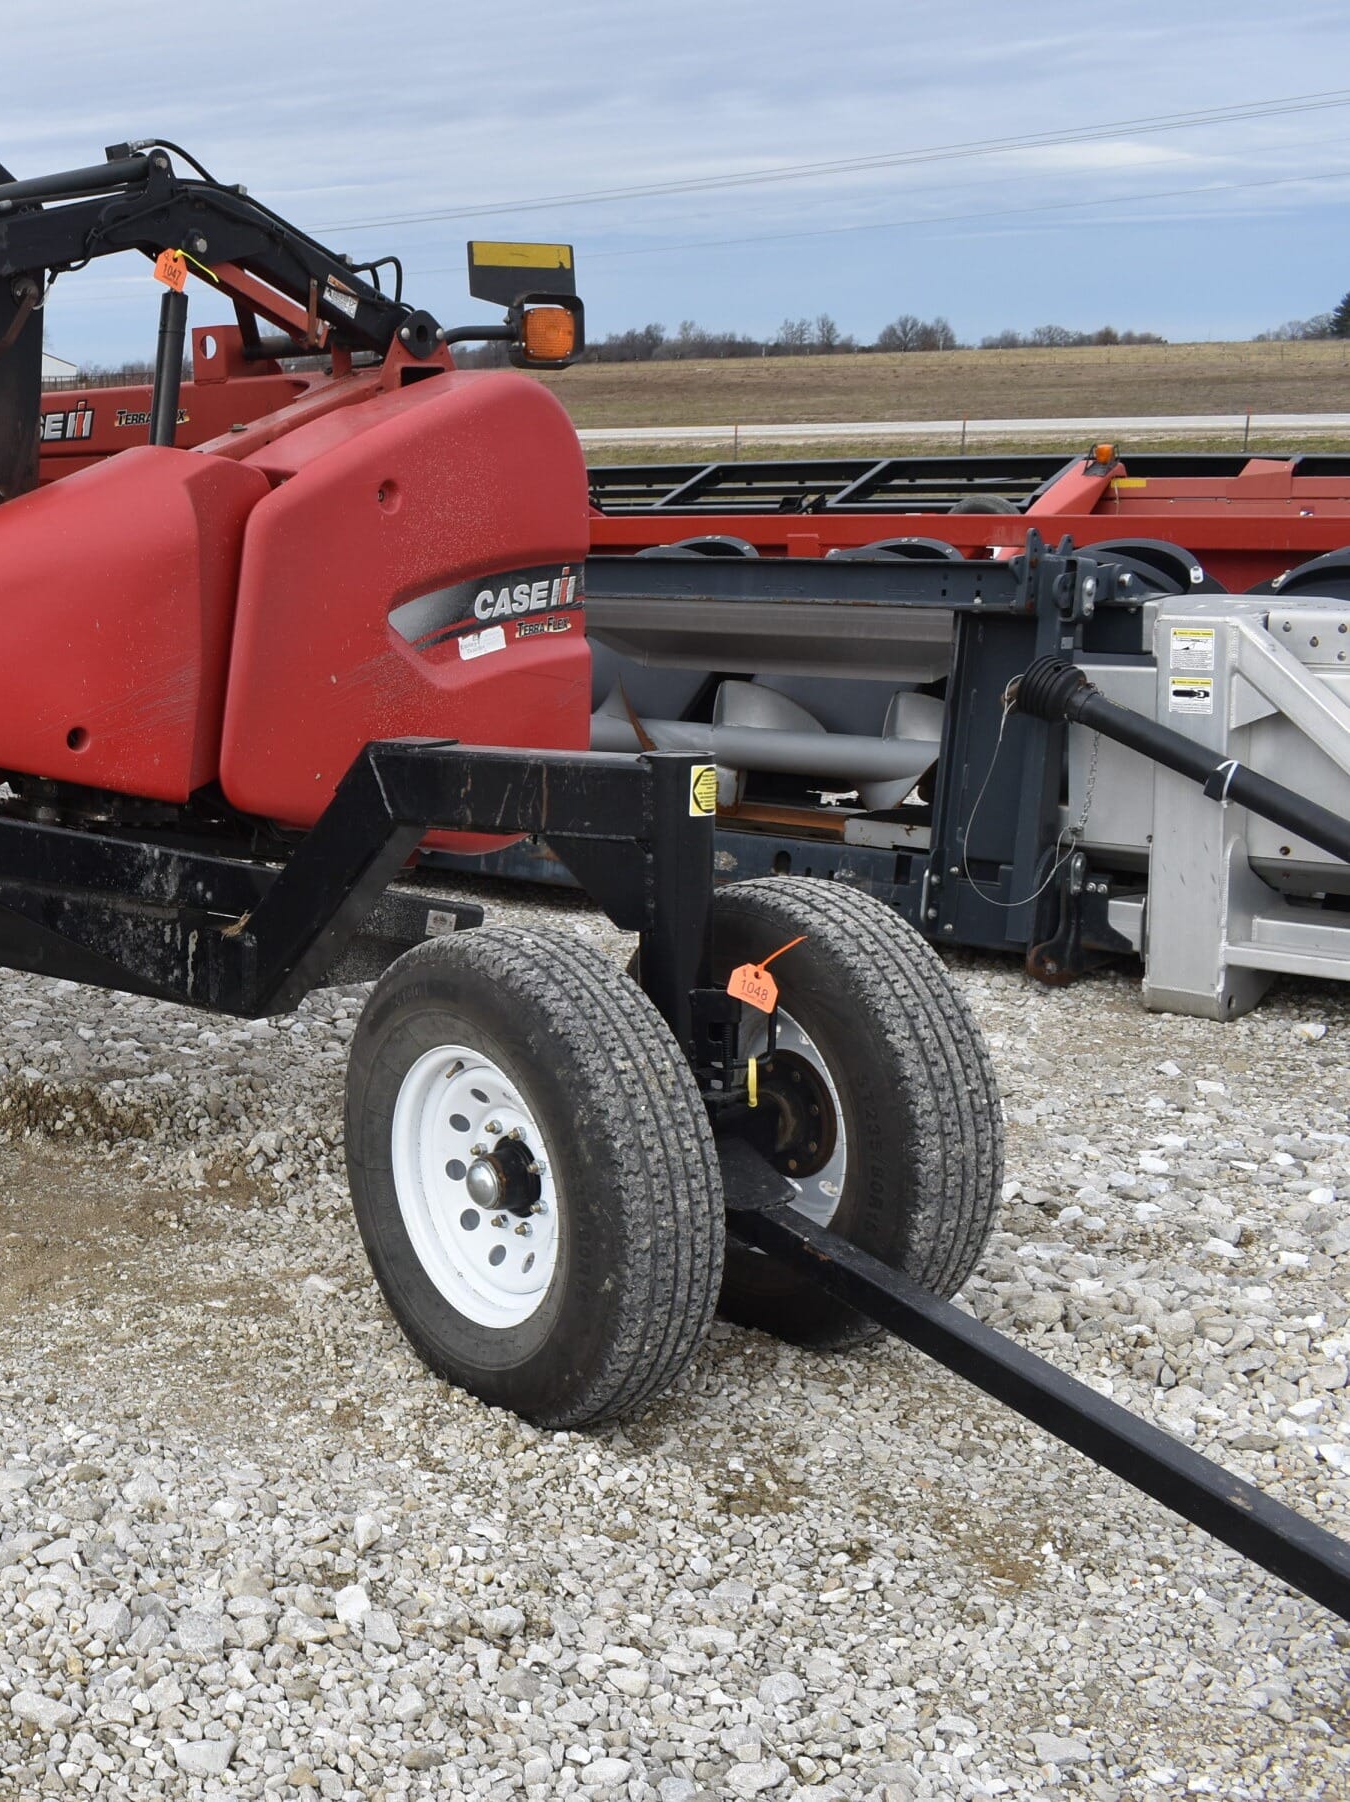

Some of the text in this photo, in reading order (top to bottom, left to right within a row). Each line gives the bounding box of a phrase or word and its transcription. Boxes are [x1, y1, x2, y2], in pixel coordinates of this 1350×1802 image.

[163, 263, 182, 281] 1047
[474, 580, 549, 620] CASE
[741, 980, 768, 1001] 1048
